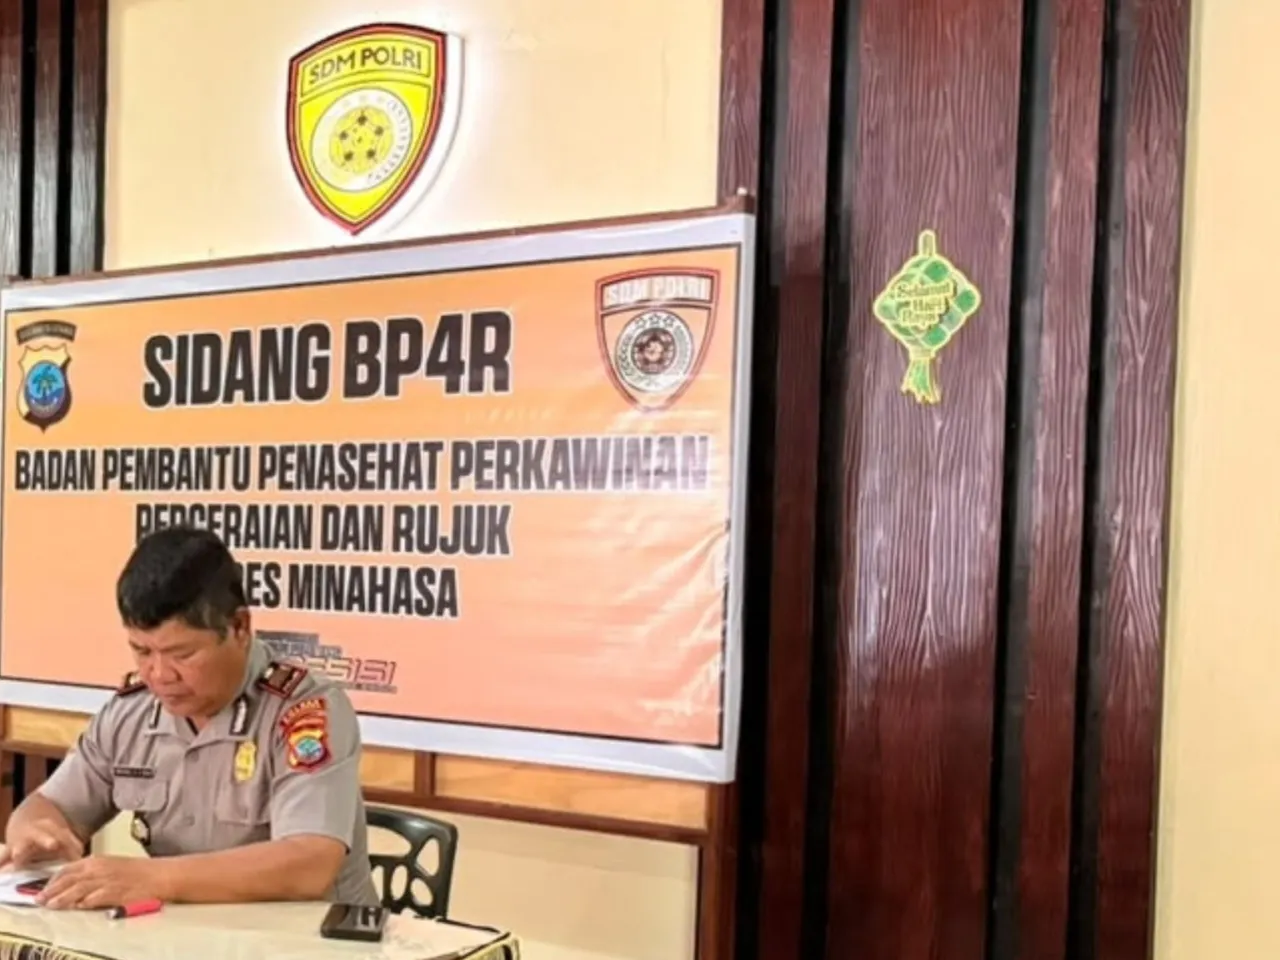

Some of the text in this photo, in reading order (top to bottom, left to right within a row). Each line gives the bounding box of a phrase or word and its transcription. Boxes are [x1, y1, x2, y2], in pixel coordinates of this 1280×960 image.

[309, 45, 422, 85] SDM POLRI
[143, 310, 512, 408] SIDANG BP4R
[14, 436, 709, 492] BADAN PEMBANTU PENASEHAT PERKAWINAN
[320, 504, 384, 552] DAN
[391, 505, 512, 555] RUJUK
[287, 563, 459, 618] MINAHASA
